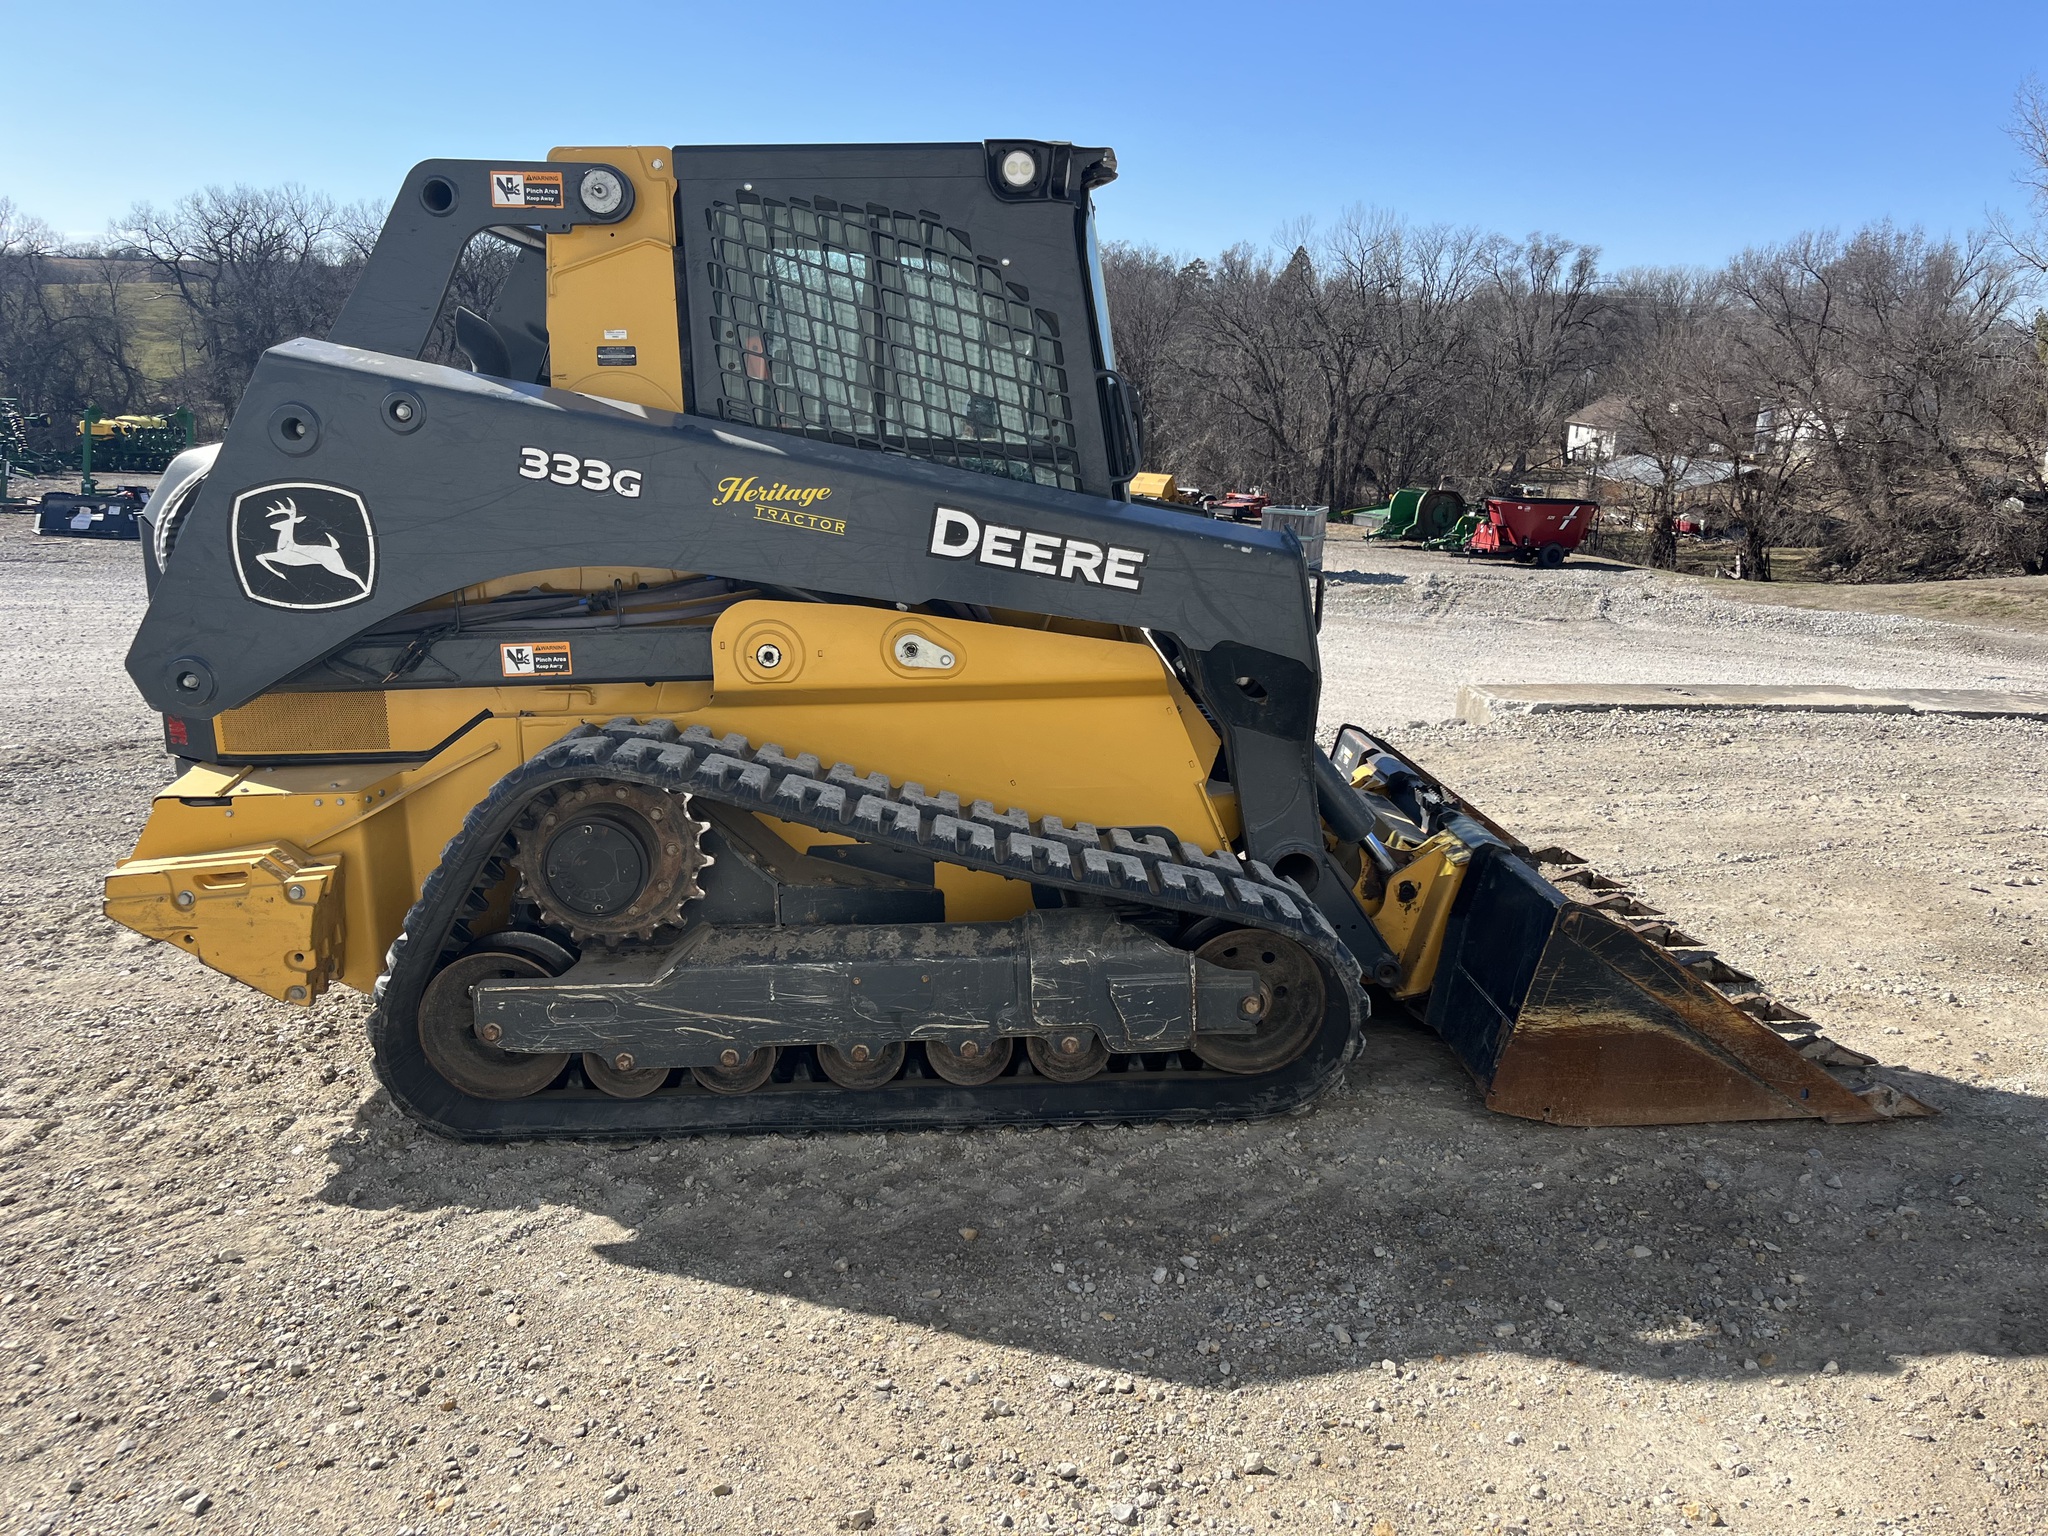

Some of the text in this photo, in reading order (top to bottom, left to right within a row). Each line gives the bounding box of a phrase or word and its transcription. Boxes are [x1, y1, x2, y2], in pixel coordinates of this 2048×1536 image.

[519, 447, 642, 498] 333G
[712, 476, 832, 507] Heritage
[754, 505, 846, 533] TRACTOR
[930, 507, 1145, 590] DEERE
